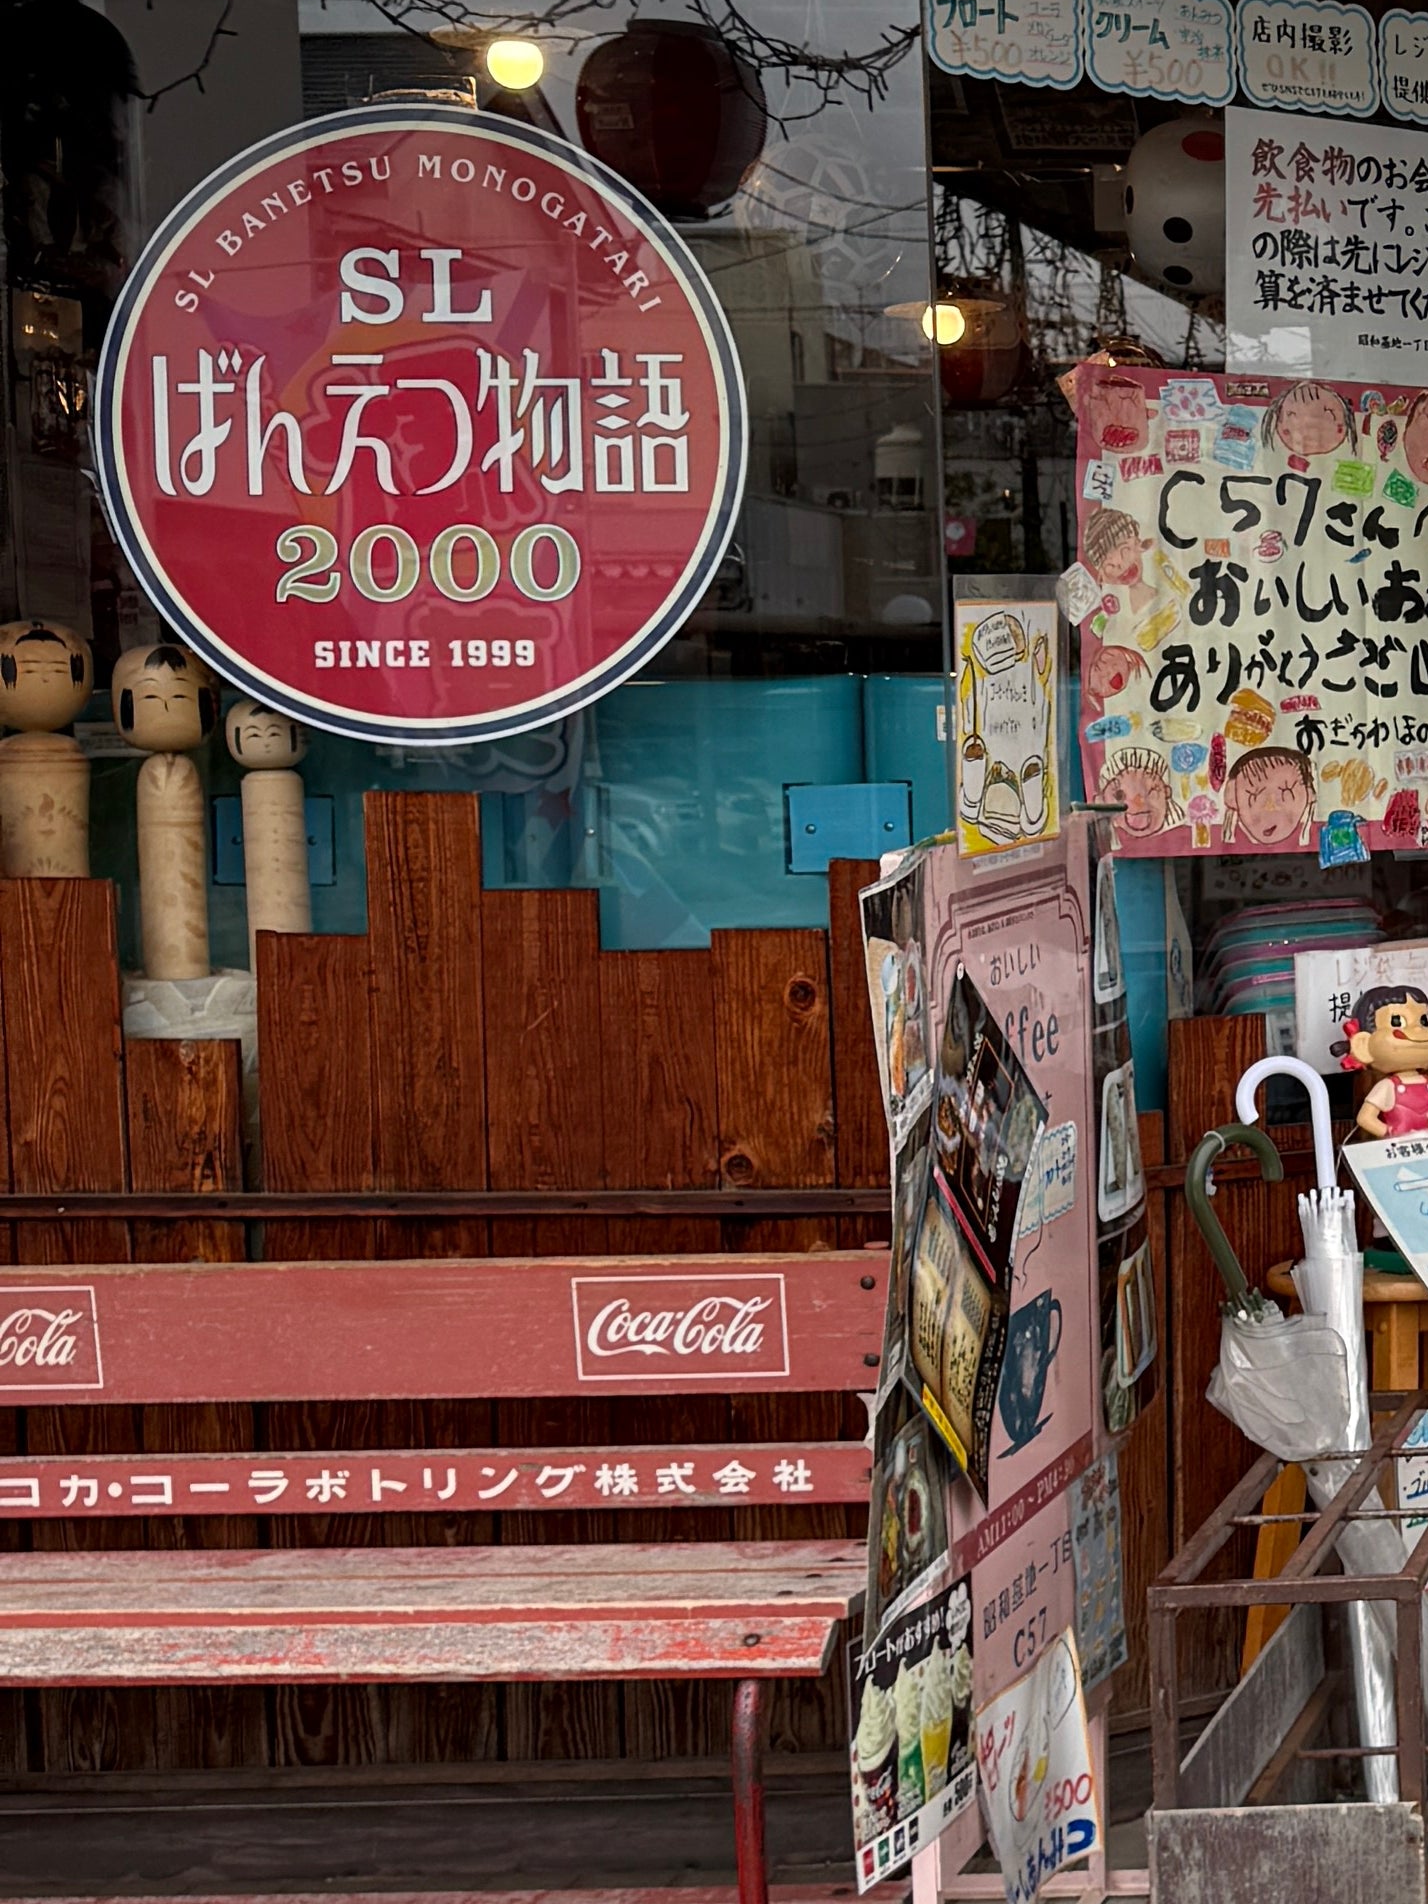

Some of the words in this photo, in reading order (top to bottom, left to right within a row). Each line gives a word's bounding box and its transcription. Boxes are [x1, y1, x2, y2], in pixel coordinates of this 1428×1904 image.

[1095, 10, 1170, 50] クリーム
[1252, 15, 1354, 56] 店内撮影
[174, 266, 216, 314] SL
[215, 154, 393, 258] BANETSU
[416, 154, 664, 314] MONOGATARI
[339, 247, 494, 325] SL
[152, 347, 691, 497] ばんえつ物語
[275, 522, 582, 603] 2000
[313, 640, 431, 669] SINCE
[448, 639, 537, 669] 1999
[989, 942, 1042, 987] おいしい
[586, 1295, 775, 1358] Coca-Cola
[1013, 1605, 1048, 1669] C57
